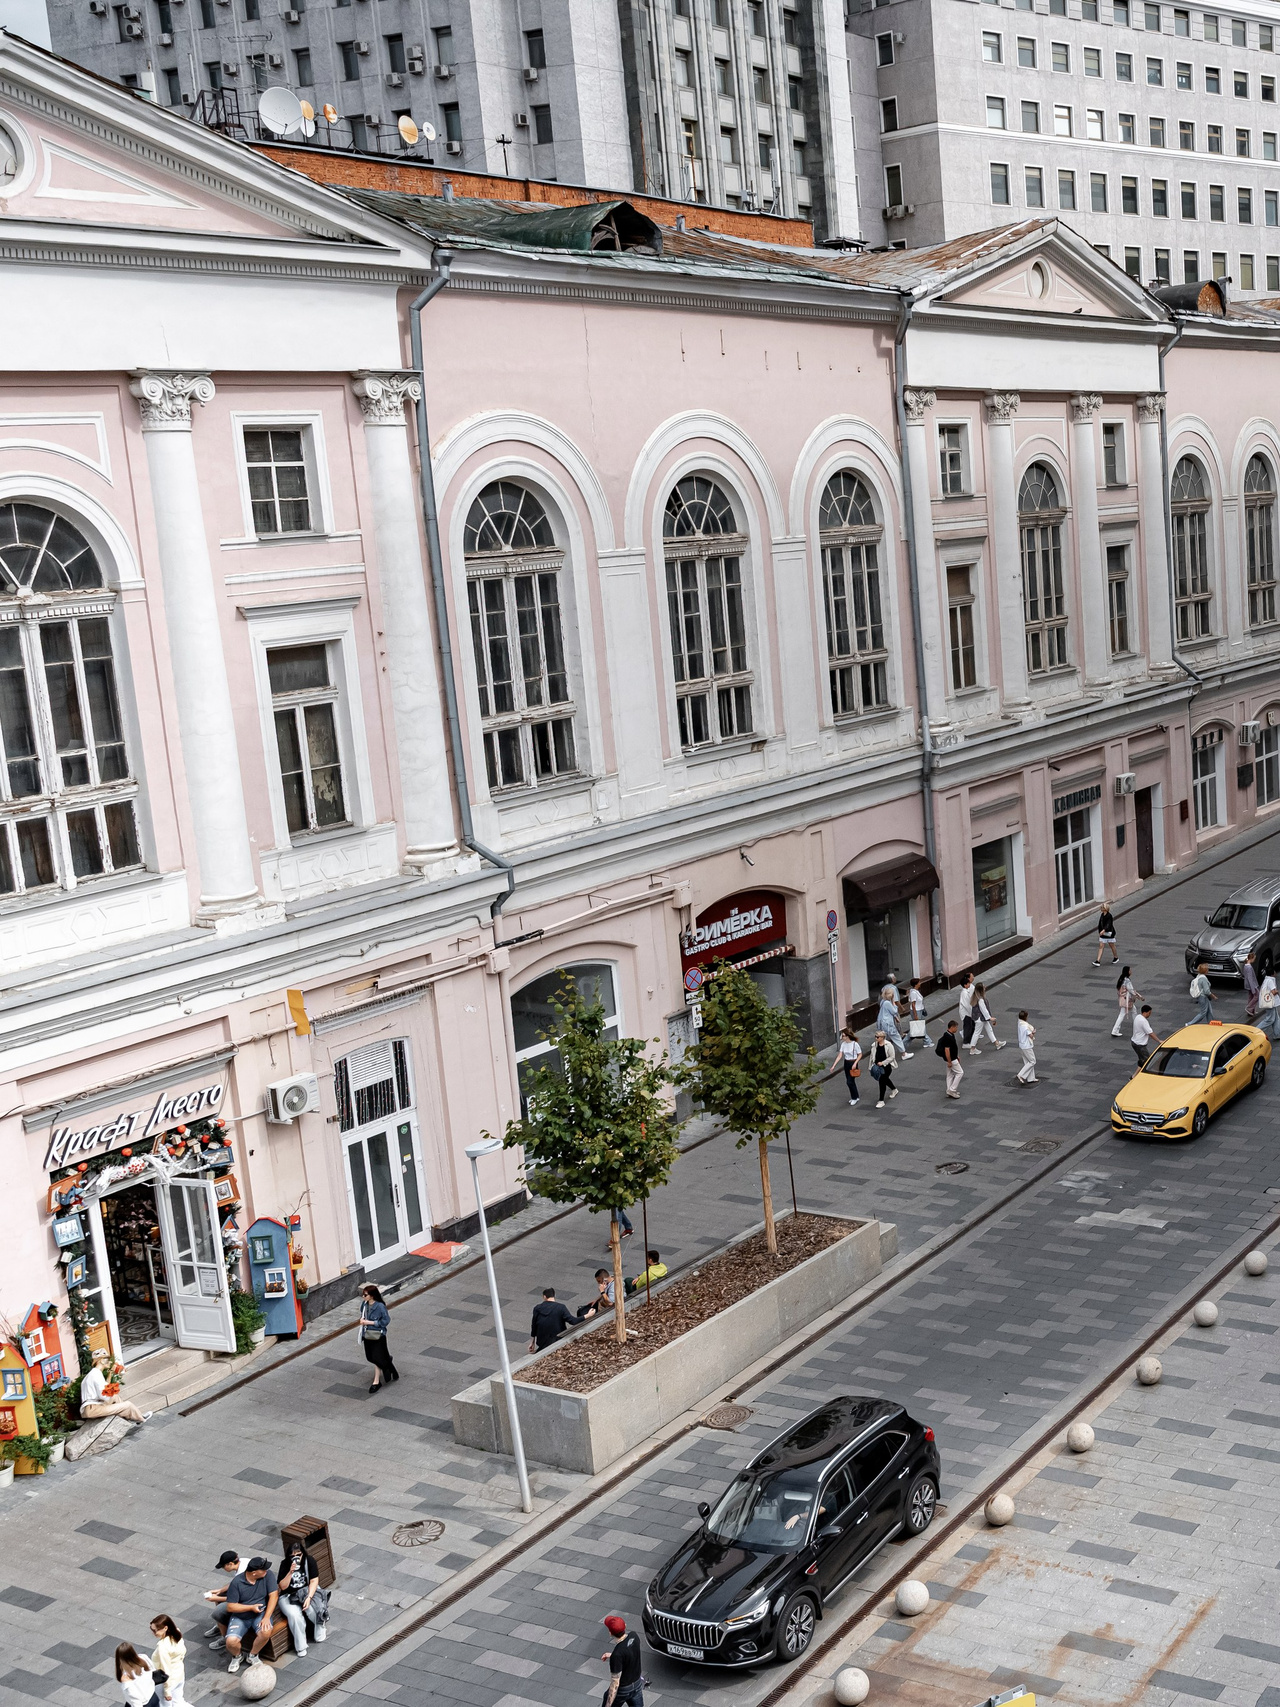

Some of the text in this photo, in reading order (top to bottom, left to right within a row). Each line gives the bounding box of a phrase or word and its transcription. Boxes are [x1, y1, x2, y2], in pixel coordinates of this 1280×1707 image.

[685, 942, 710, 956] GASTRO
[710, 936, 727, 947] CLUB
[732, 924, 760, 940] KARAOKE
[760, 920, 773, 930] BAR
[43, 1084, 224, 1170] Крафт Место
